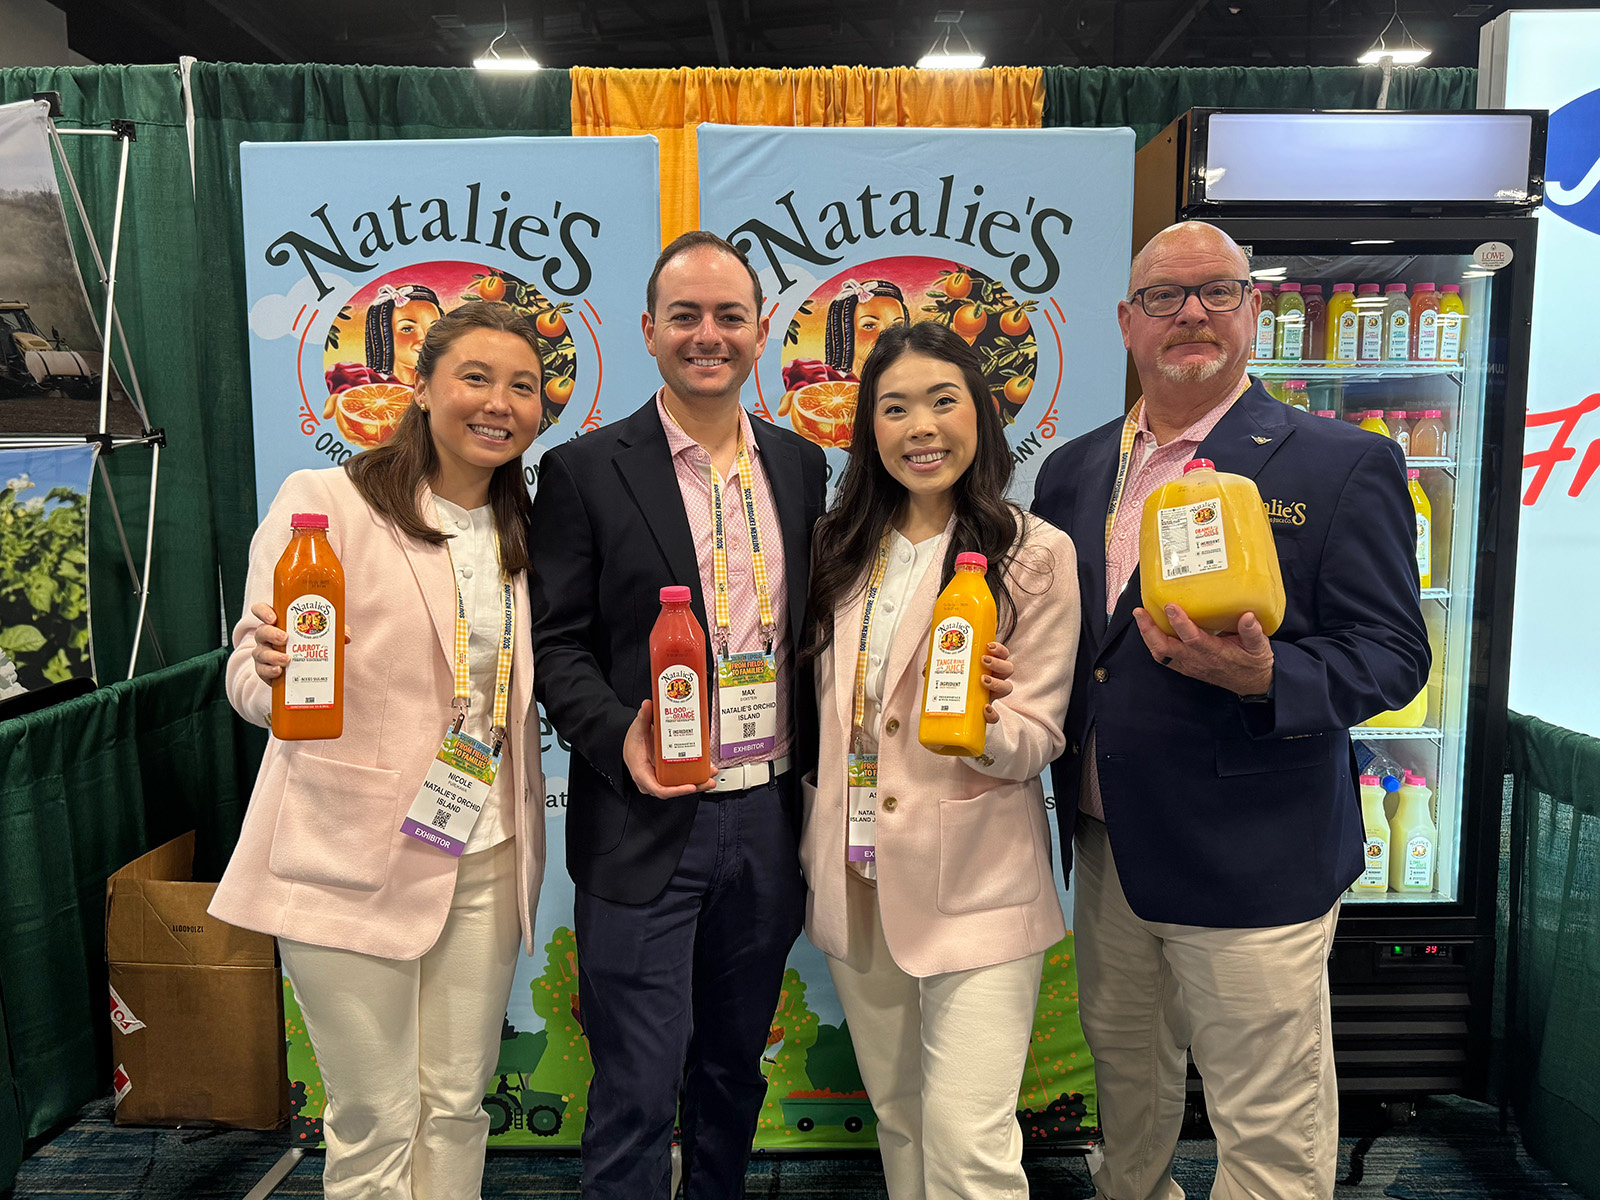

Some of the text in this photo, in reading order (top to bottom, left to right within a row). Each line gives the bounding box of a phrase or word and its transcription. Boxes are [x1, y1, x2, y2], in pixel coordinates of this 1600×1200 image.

[1481, 252, 1505, 260] LOWE
[746, 501, 756, 526] EXPOSURE
[715, 510, 723, 536] EXPOSURE
[750, 527, 760, 553] SOUTHERN
[863, 599, 875, 625] EXPOSURE
[504, 610, 512, 636] EXPOSURE
[859, 625, 869, 652] SOUTHERN
[292, 644, 320, 653] CARROT
[304, 649, 329, 659] JUICE
[731, 659, 764, 670] FROM FIELDS
[936, 659, 965, 667] TANGERINE
[945, 664, 965, 673] JUICE
[740, 666, 764, 676] FAMILIES
[664, 706, 687, 715] BLOOD
[672, 710, 695, 719] ORANGE
[721, 702, 776, 715] NATALIE'S ORCHID
[738, 712, 761, 721] ISLAND
[456, 740, 472, 754] FROM
[471, 748, 489, 763] FIELDS
[733, 742, 765, 754] EXHIBITOR
[454, 748, 462, 757] TO
[461, 751, 487, 770] FAMILIES
[448, 772, 473, 789] NICOLE
[423, 780, 481, 813] NATALIE'S ORCHID
[436, 797, 461, 814] ISLAND
[414, 827, 451, 849] EXHIBITOR
[1425, 945, 1438, 954] 39
